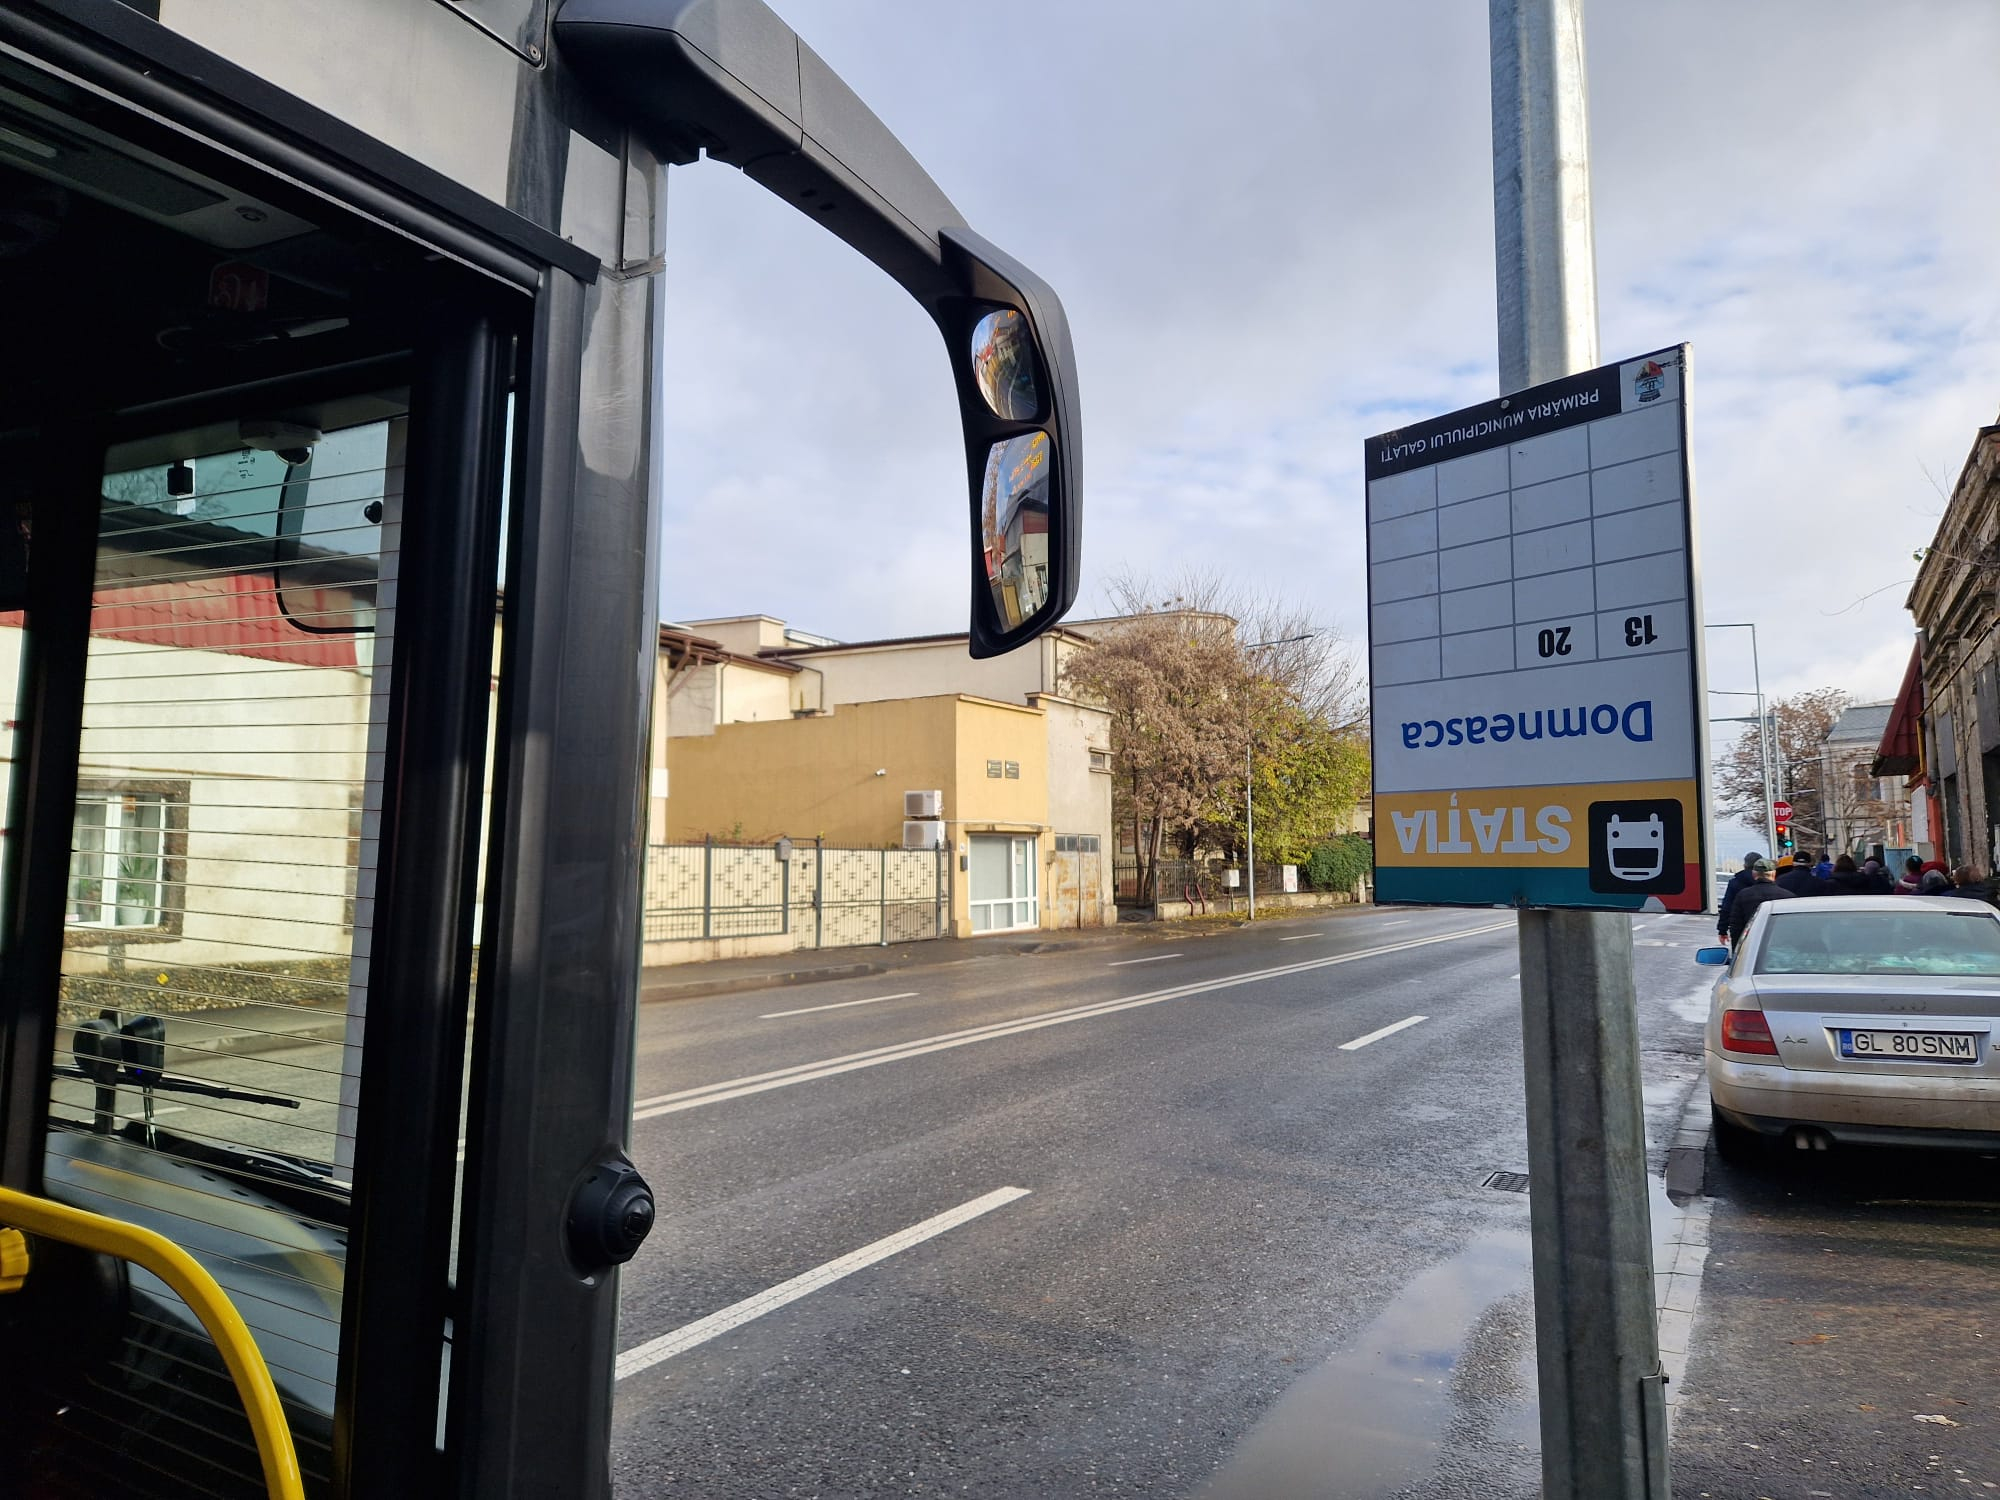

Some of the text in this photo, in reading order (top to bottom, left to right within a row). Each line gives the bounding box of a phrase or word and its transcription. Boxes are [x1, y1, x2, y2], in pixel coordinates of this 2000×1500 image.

[1527, 388, 1600, 420] PRIMĂRIA
[1431, 409, 1525, 449] MUNICIPIULUI
[1537, 614, 1658, 658] 13 20
[1401, 700, 1654, 749] Domneasca
[1390, 792, 1573, 854] STAȚIA
[1774, 807, 1792, 816] TOP
[1854, 1033, 1884, 1052] GL
